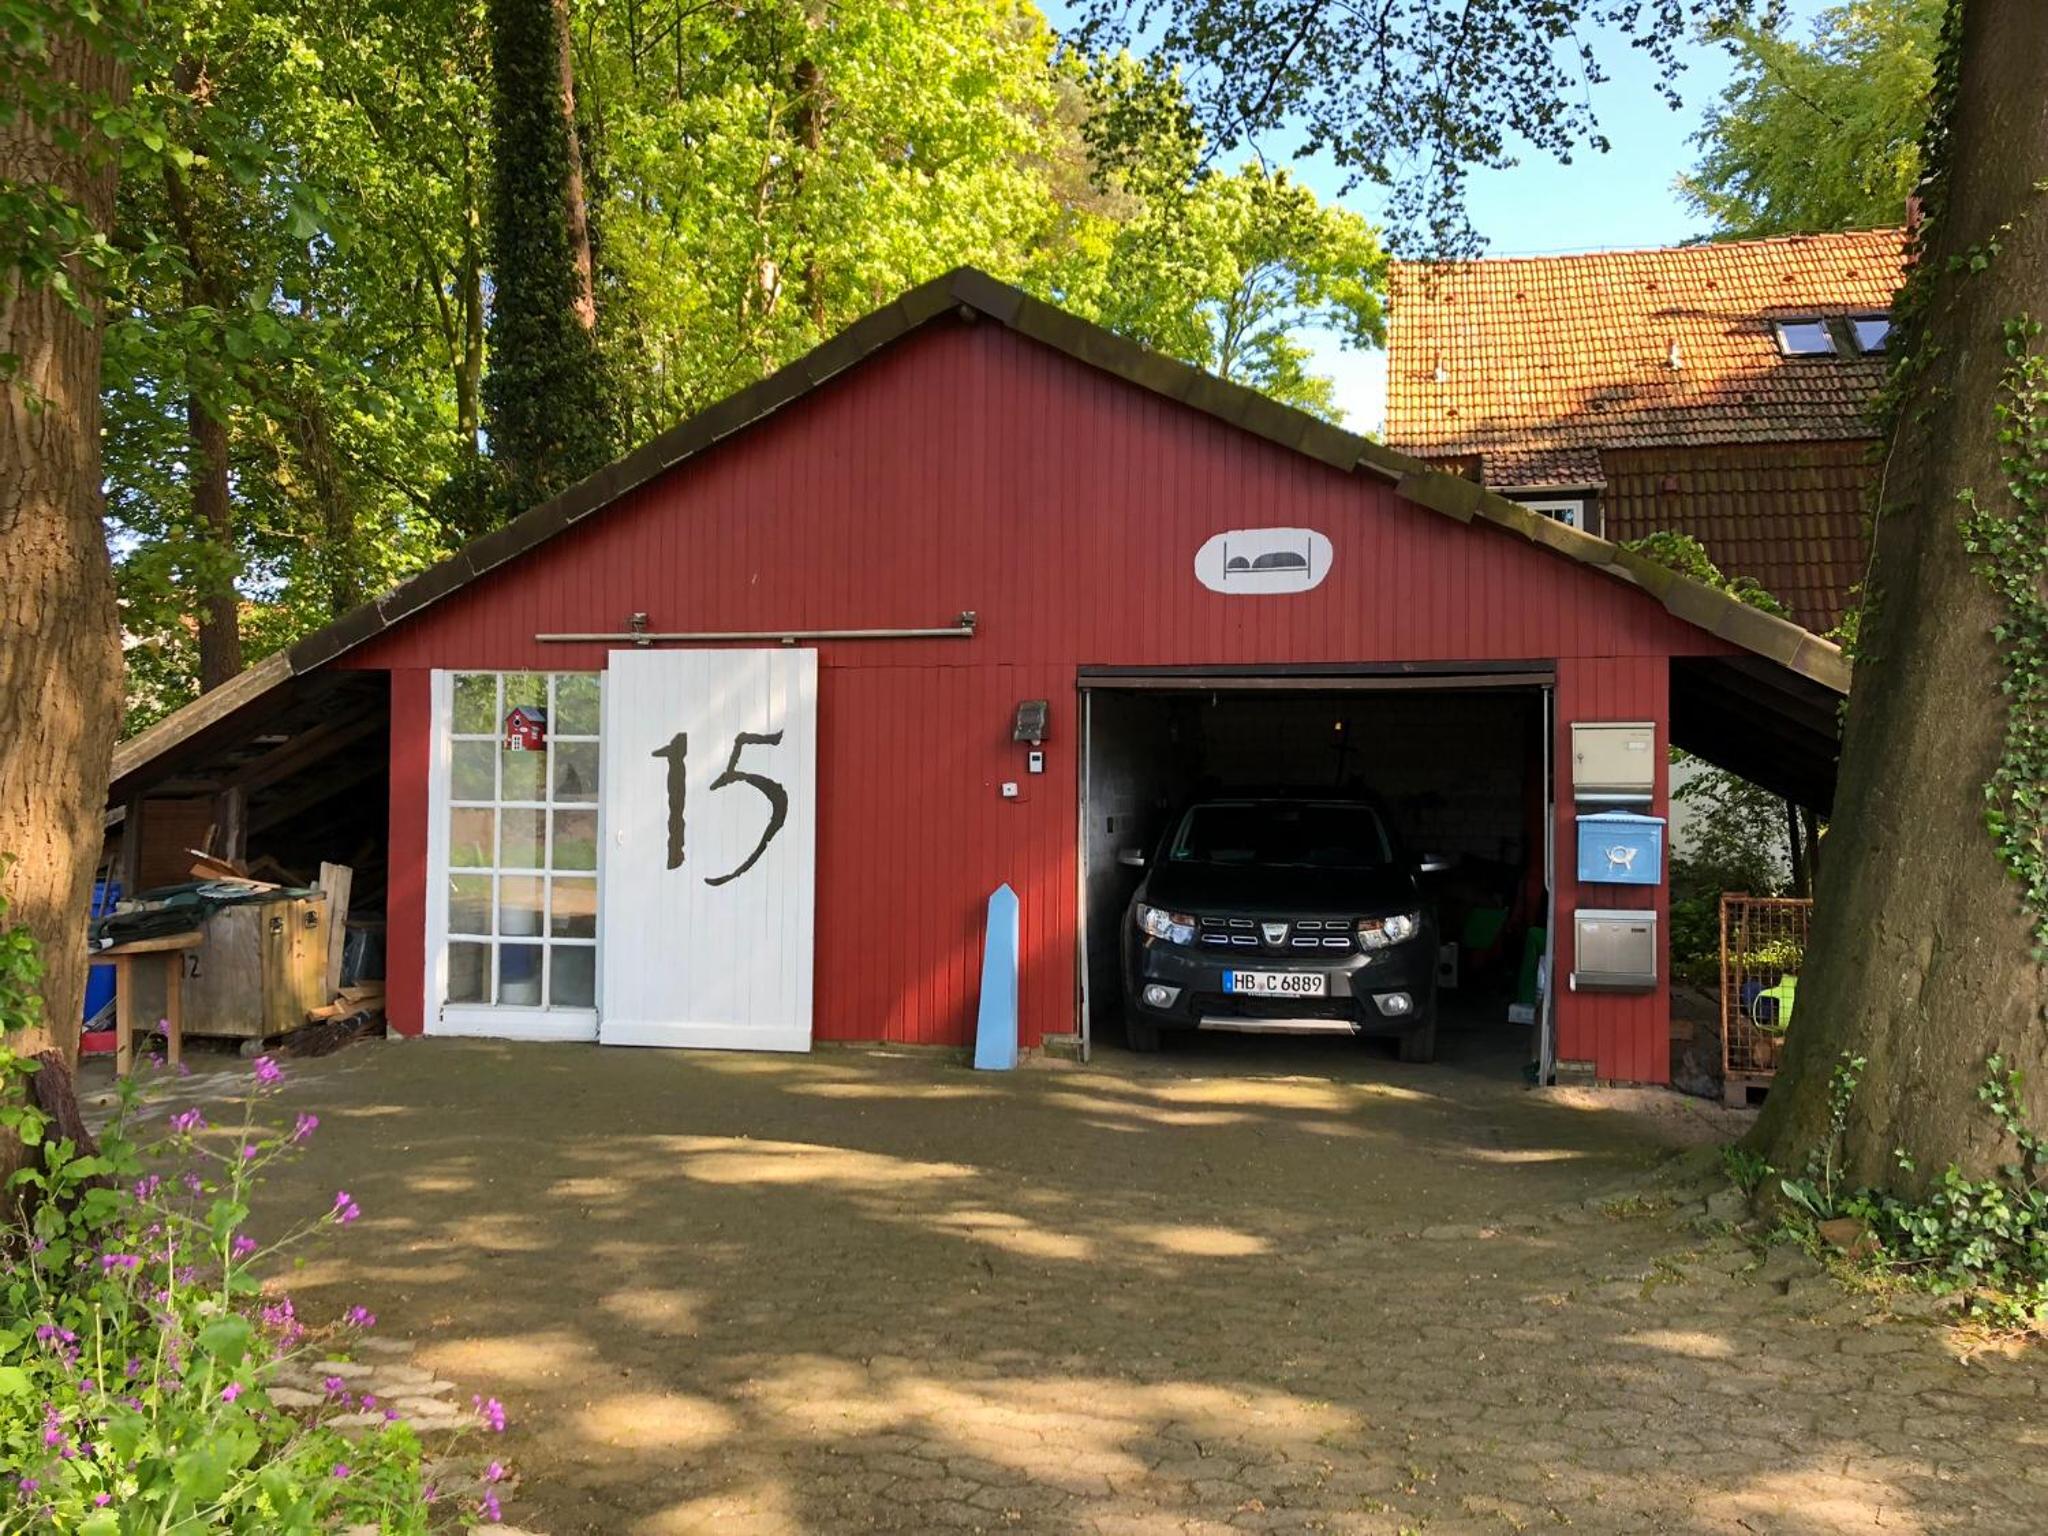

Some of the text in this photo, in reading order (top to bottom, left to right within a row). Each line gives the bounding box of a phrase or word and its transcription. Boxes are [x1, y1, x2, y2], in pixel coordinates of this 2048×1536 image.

[652, 729, 789, 887] 15
[1234, 974, 1323, 992] HB C 6889
